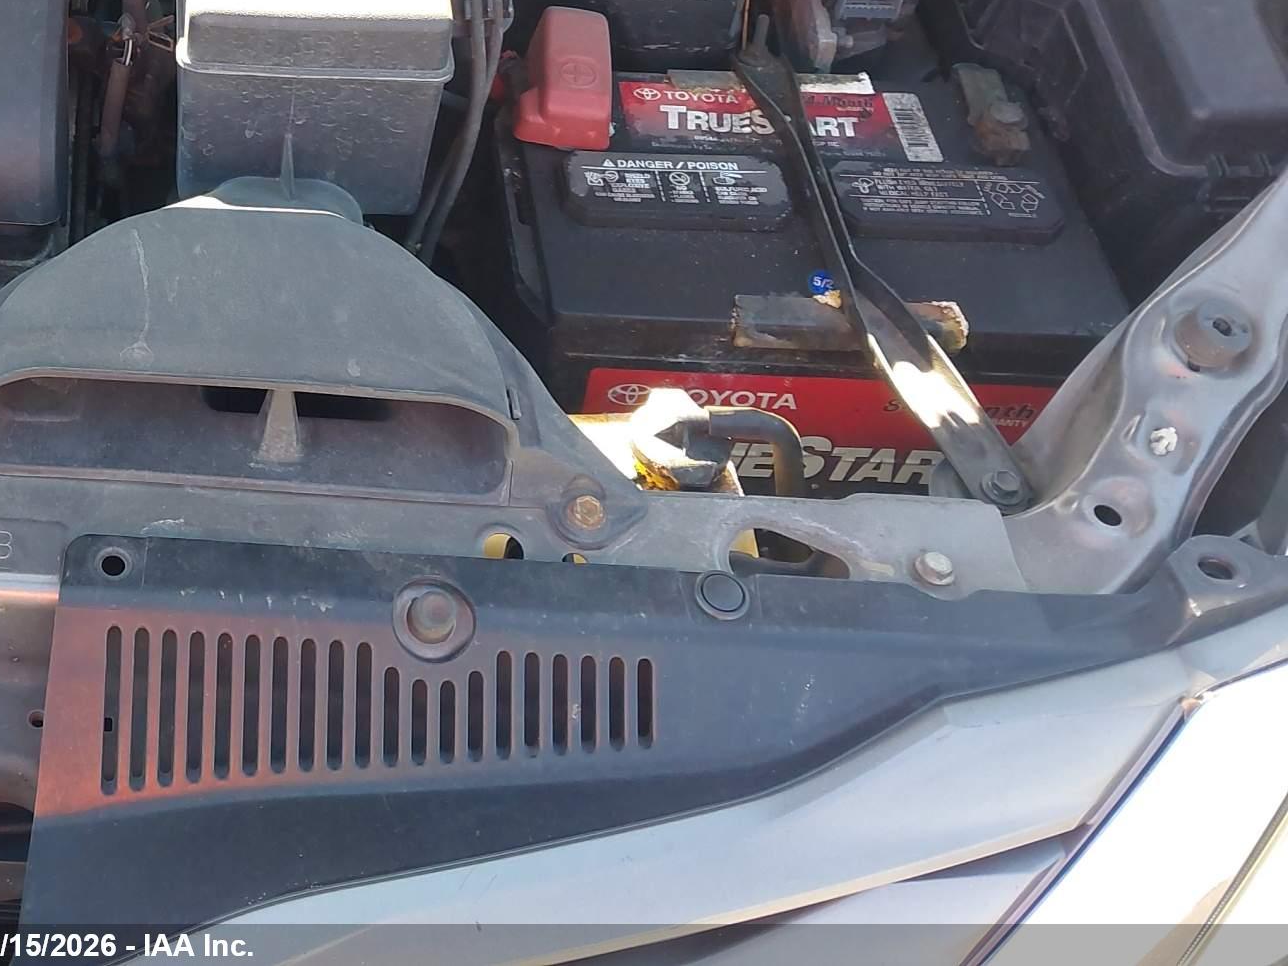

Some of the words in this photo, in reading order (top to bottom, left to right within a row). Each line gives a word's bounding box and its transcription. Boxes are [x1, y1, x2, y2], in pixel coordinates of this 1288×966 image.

[663, 89, 739, 104] TOYOTA
[660, 105, 858, 138] TRUESRT
[616, 159, 674, 170] DANGER
[687, 162, 739, 171] POISON
[687, 389, 797, 410] OYOTA
